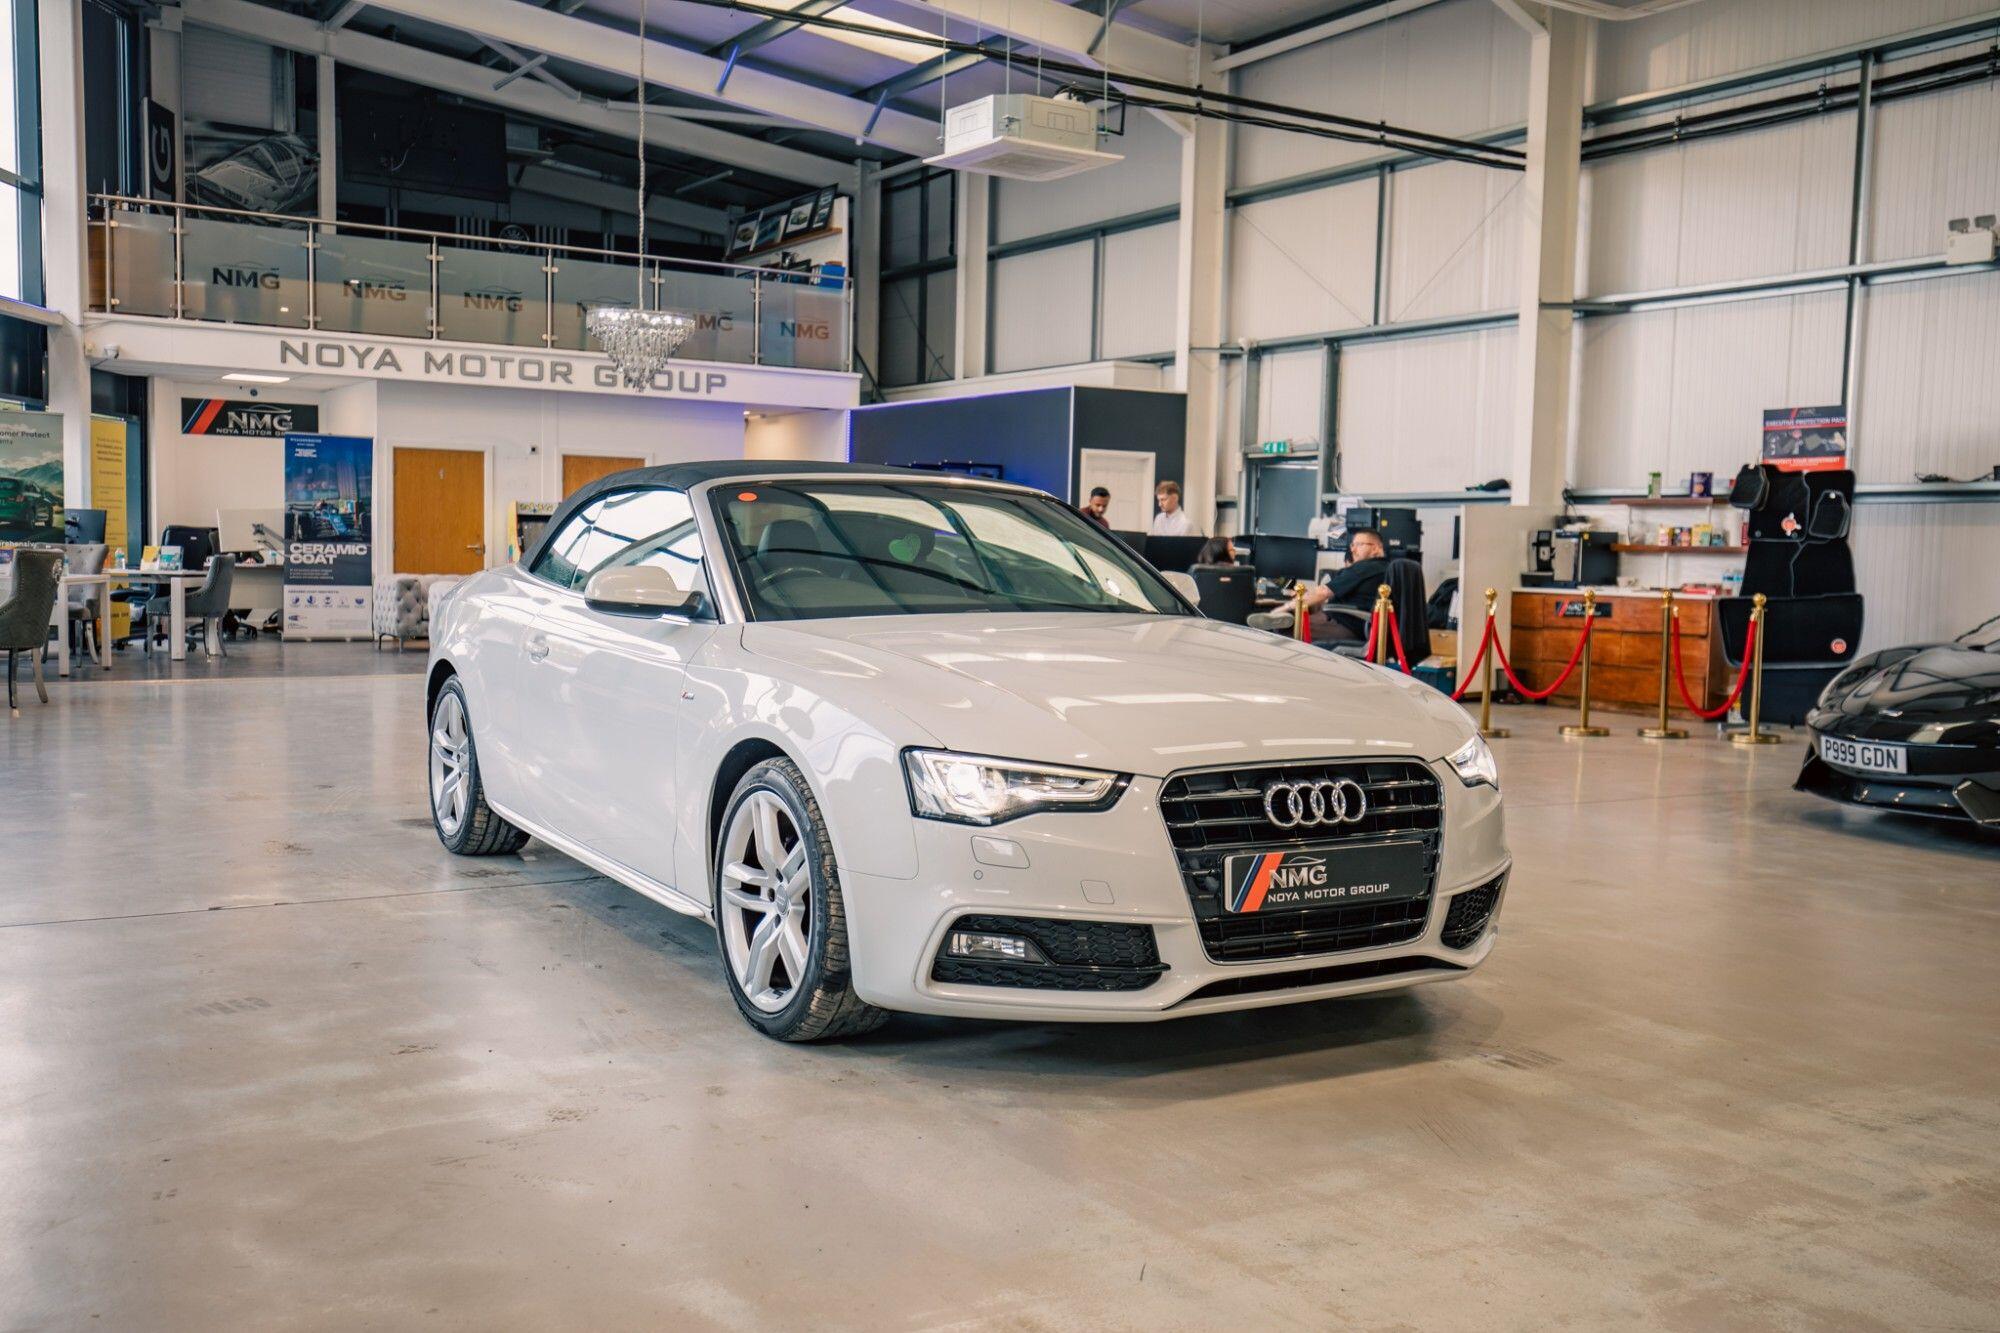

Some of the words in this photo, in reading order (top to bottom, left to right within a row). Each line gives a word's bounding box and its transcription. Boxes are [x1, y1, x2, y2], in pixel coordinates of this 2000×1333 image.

[212, 267, 280, 290] NMG
[343, 280, 407, 301] NMG
[464, 292, 524, 312] NMG
[693, 314, 733, 332] MG
[780, 321, 829, 340] NMG
[280, 340, 402, 372] NOYA
[424, 351, 573, 385] MOTOR
[594, 364, 727, 394] GOUP
[227, 411, 293, 431] NMG
[289, 543, 368, 555] CERAMIC
[289, 553, 338, 565] COAT
[1825, 739, 1856, 764] P999
[1861, 746, 1898, 769] GDN
[1269, 865, 1328, 889] NMG
[1268, 891, 1300, 903] NOYA
[1304, 887, 1346, 899] MOTOR
[1350, 883, 1390, 896] GROUP
